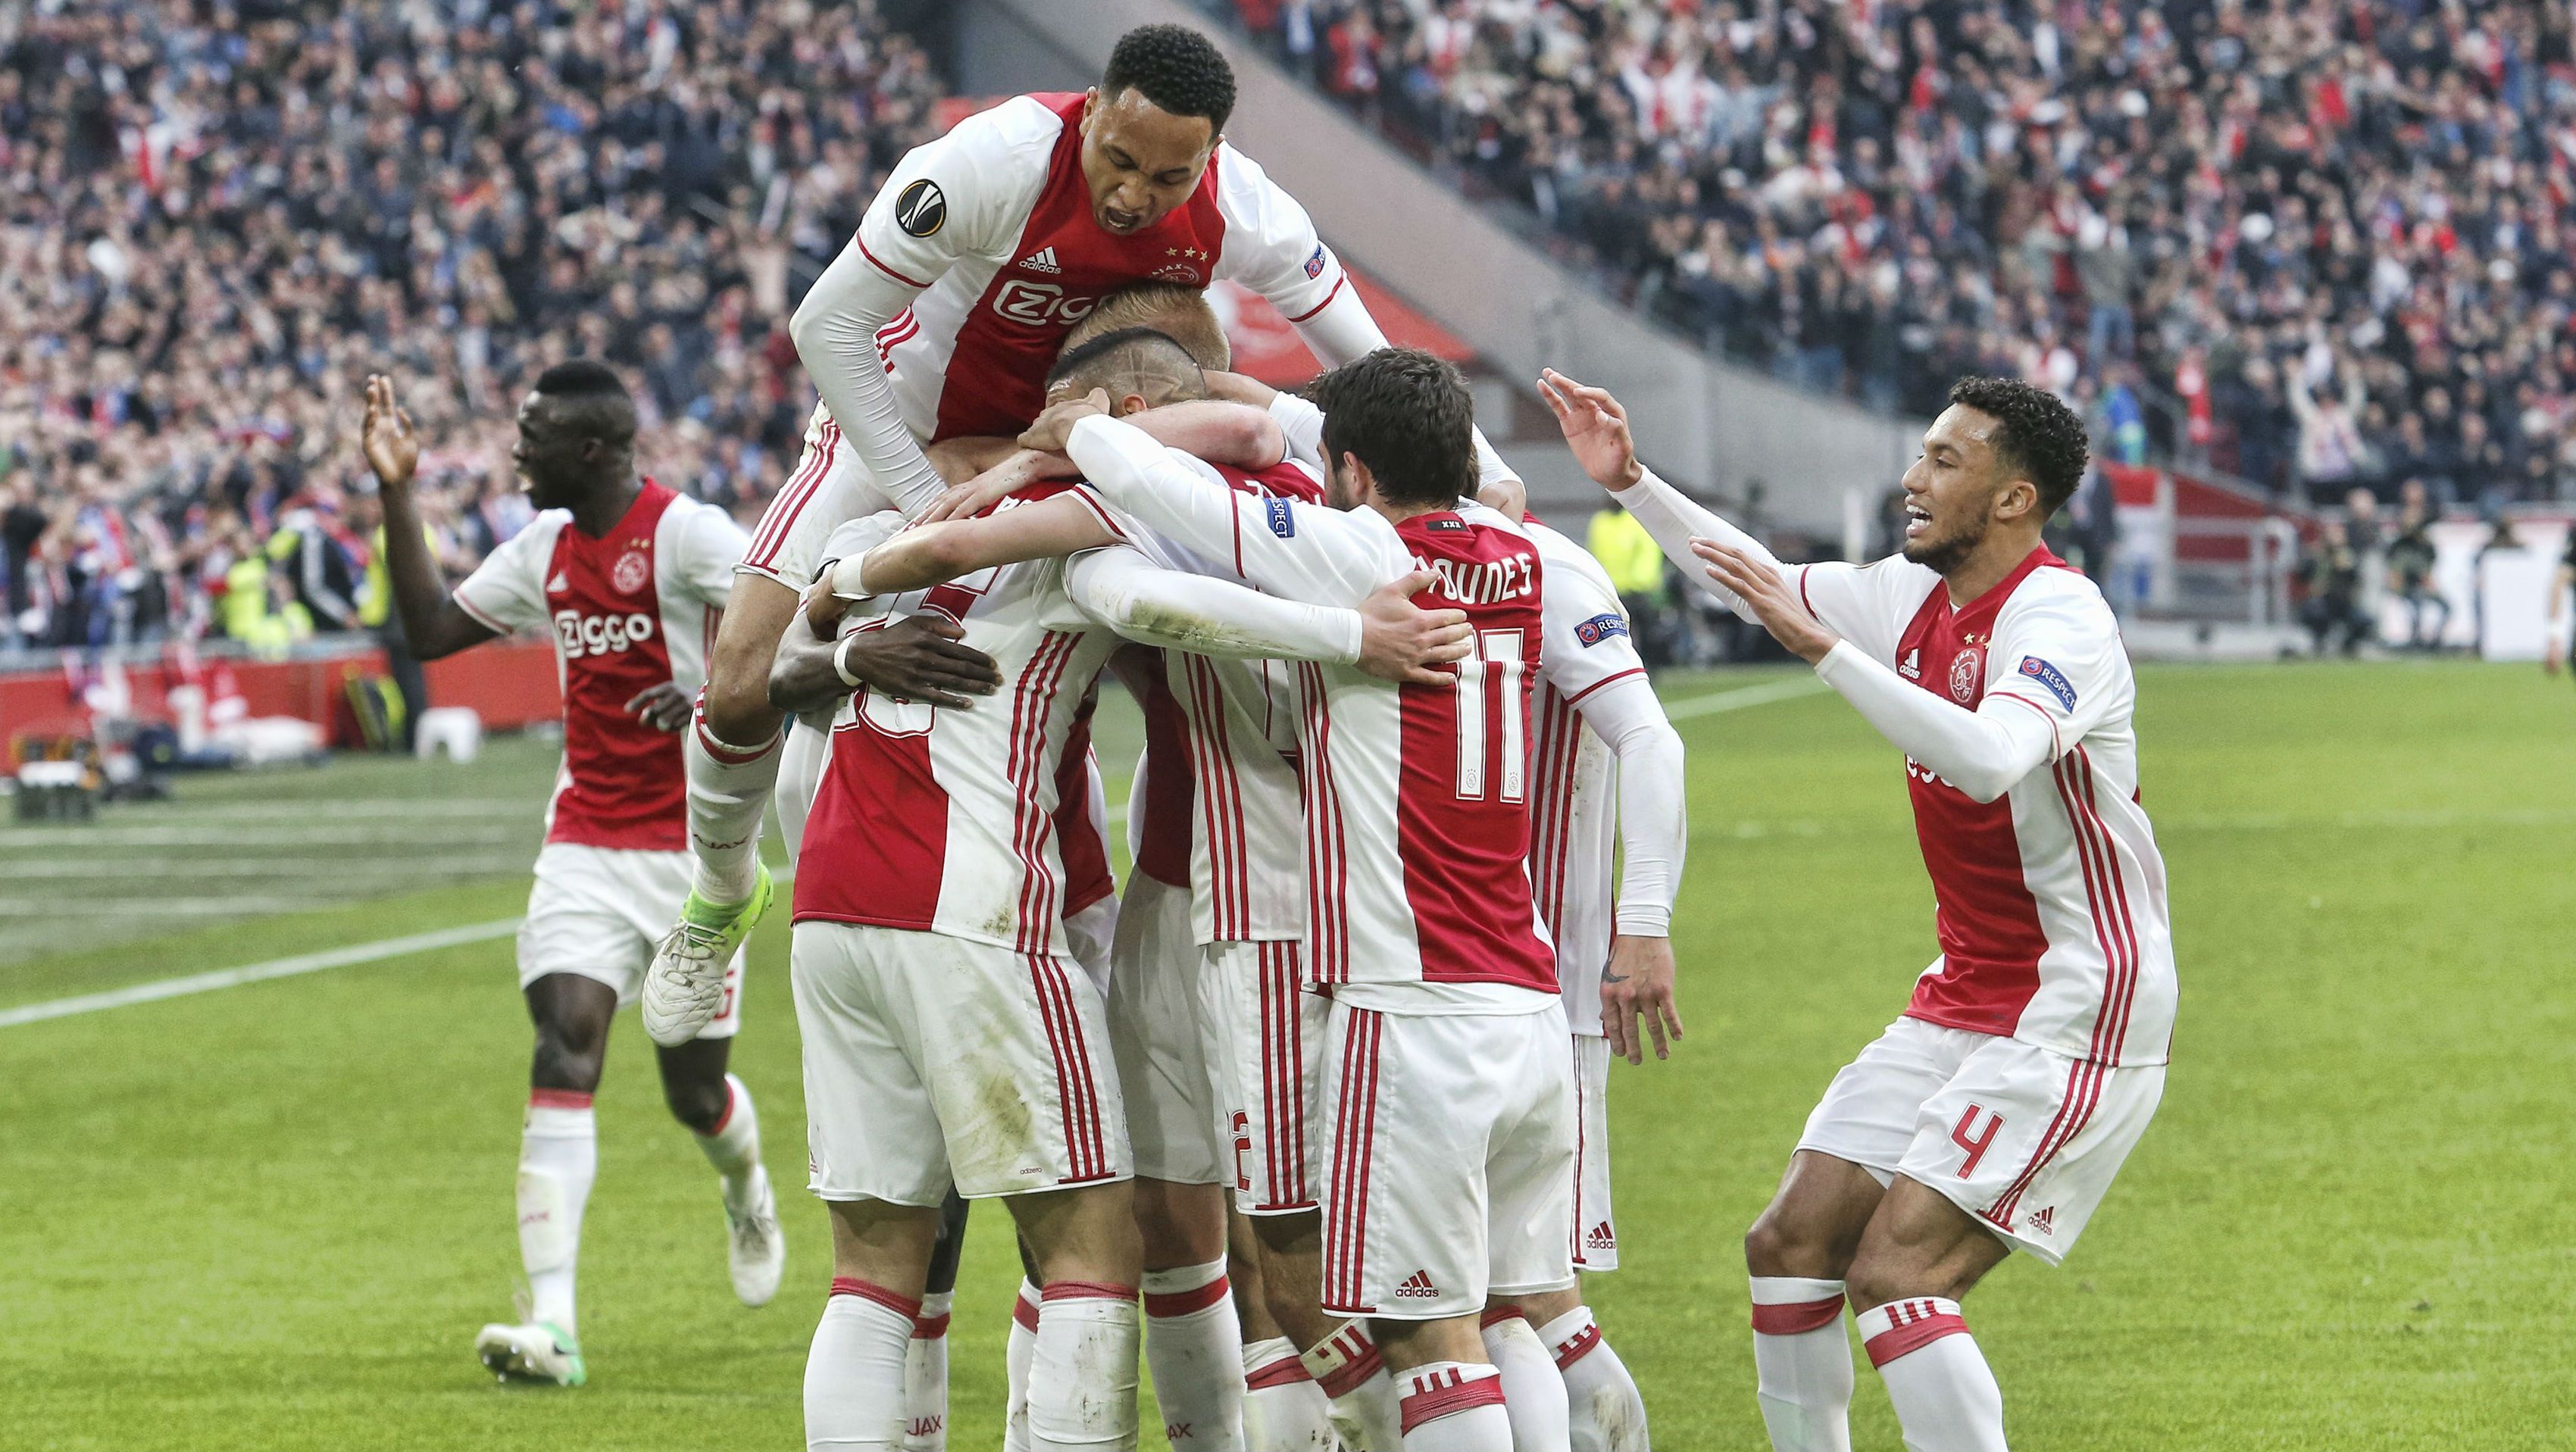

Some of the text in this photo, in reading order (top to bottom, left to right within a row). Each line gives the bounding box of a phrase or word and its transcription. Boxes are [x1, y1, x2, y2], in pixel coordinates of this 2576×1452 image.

[1018, 258, 1061, 274] adidas
[2041, 668, 2075, 707] RESPECT
[1447, 628, 1524, 804] 11
[1949, 1101, 2006, 1182] 4
[1395, 1286, 1440, 1297] adidas
[905, 1414, 942, 1437] JAX
